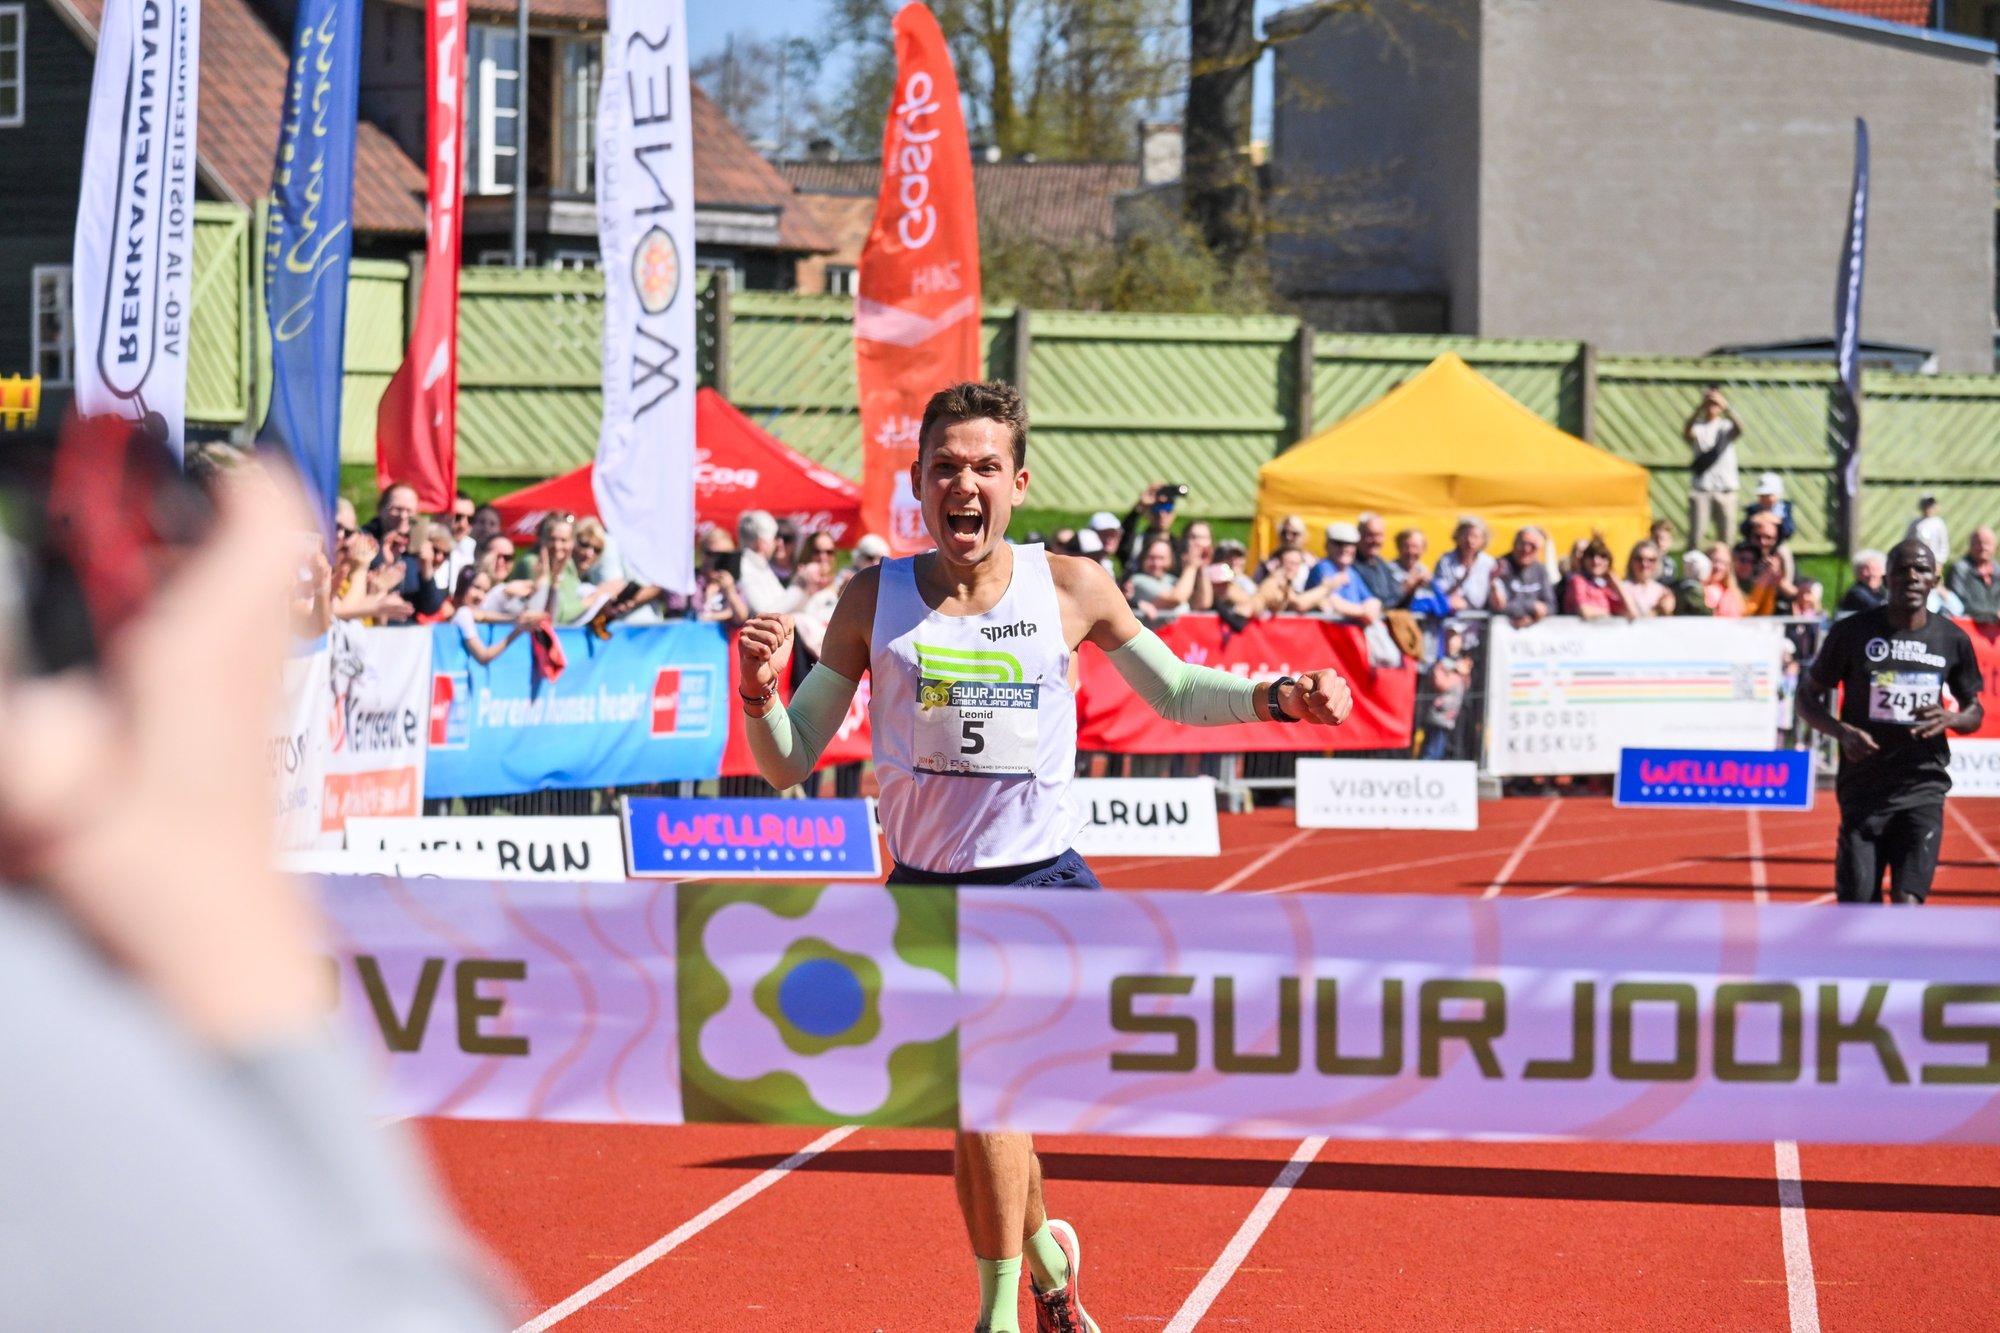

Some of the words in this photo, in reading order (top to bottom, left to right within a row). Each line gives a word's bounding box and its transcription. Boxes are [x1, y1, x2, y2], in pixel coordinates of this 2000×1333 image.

[980, 620, 1037, 643] sparta
[1891, 639, 1927, 654] TARTU
[1891, 649, 1946, 668] TEENUSED
[952, 687, 1034, 700] SUURJOOKS
[978, 699, 1009, 707] VILJANDI
[1877, 690, 1932, 710] 2418
[959, 710, 993, 719] Leonid
[960, 721, 985, 755] 5
[1640, 758, 1789, 787] WELLRUN
[1330, 774, 1445, 800] viavelo
[1092, 800, 1188, 827] LRUN
[658, 812, 845, 849] WELLRUN
[1110, 974, 2000, 1086] SUURJOOKS
